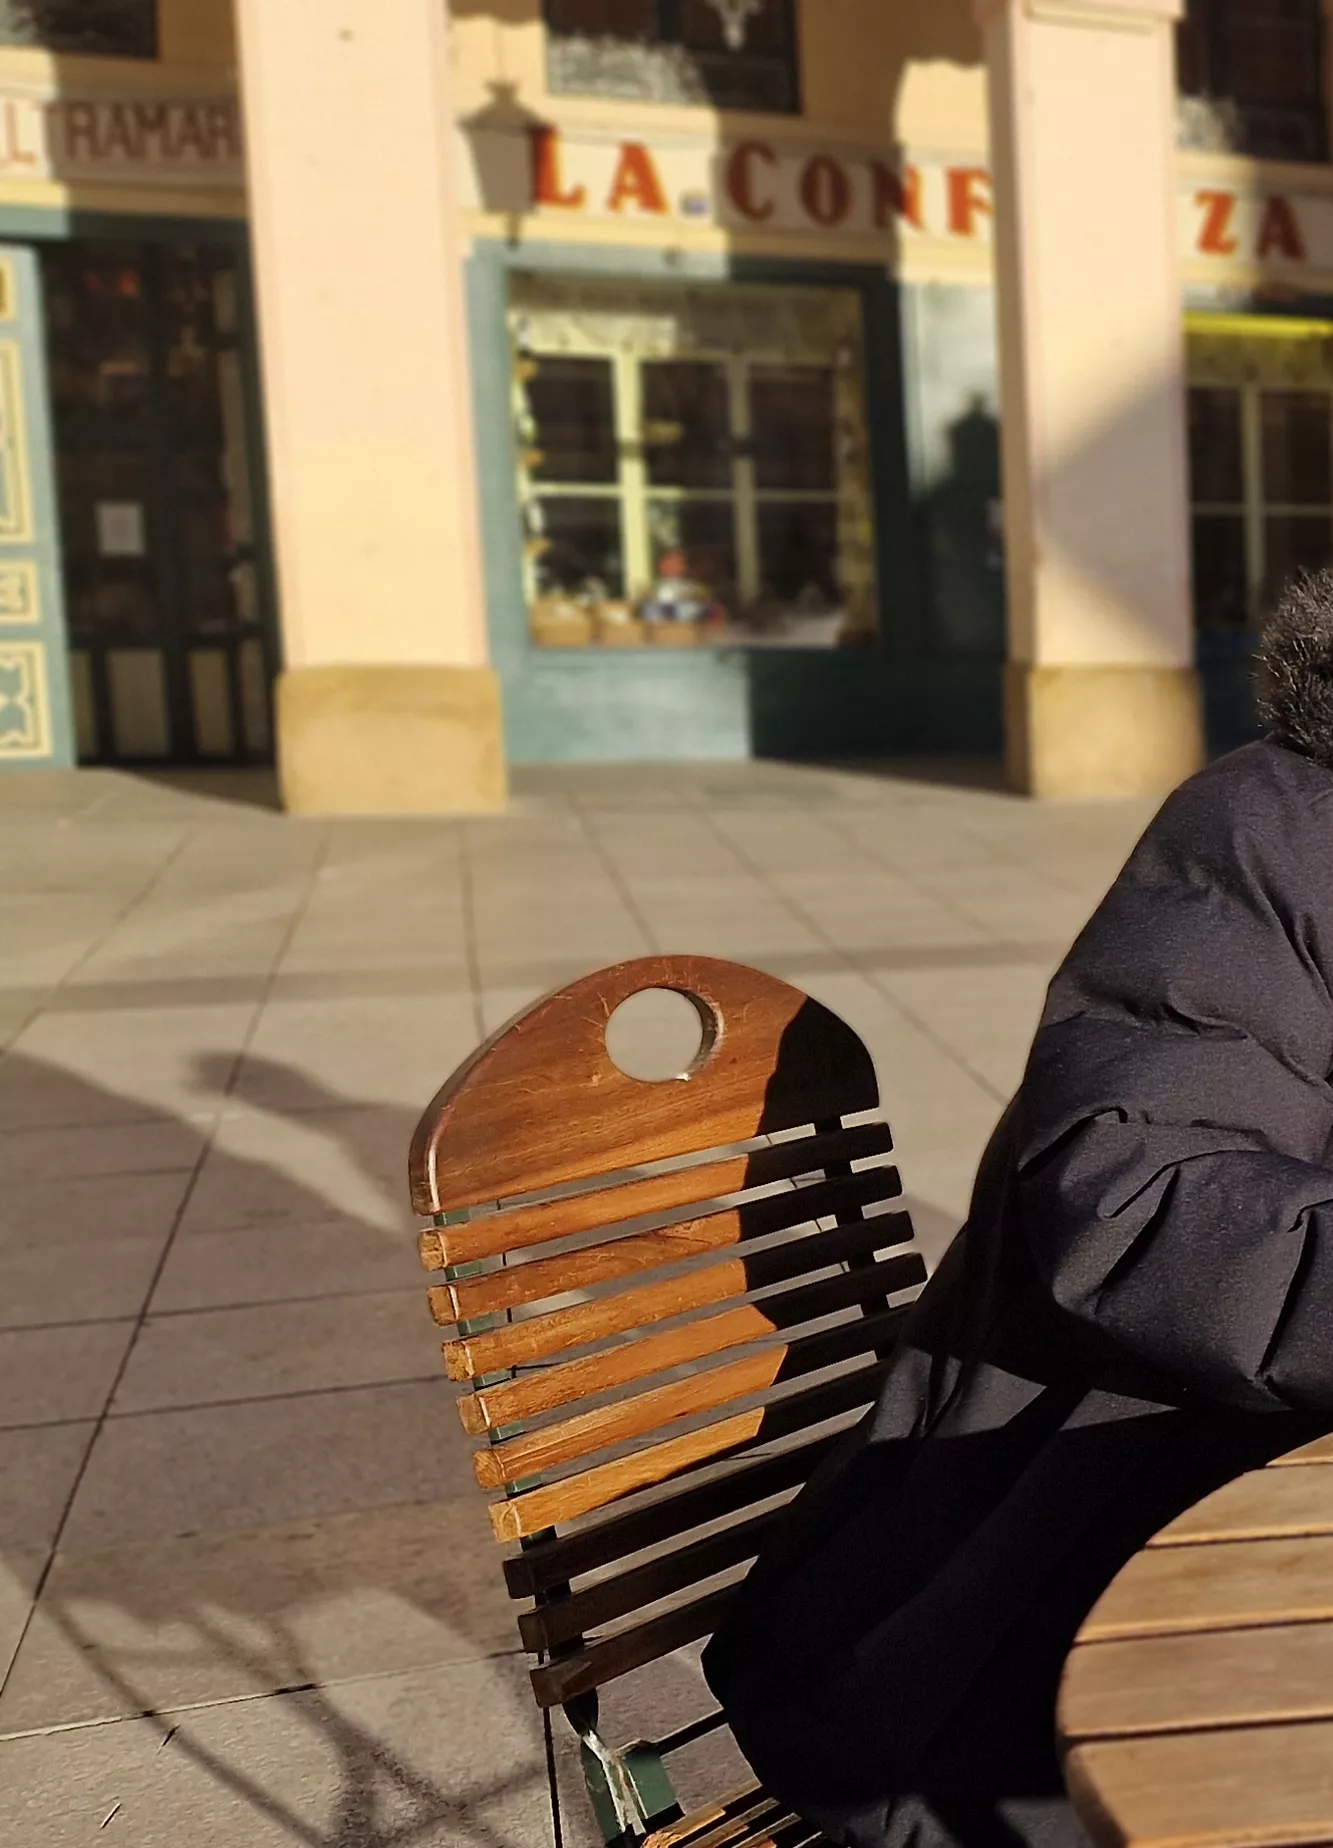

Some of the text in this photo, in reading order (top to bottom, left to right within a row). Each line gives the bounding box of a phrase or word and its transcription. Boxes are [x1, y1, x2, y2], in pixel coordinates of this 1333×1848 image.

[0, 98, 241, 166] LTRAMAR
[525, 123, 1307, 261] LA CONFZA
